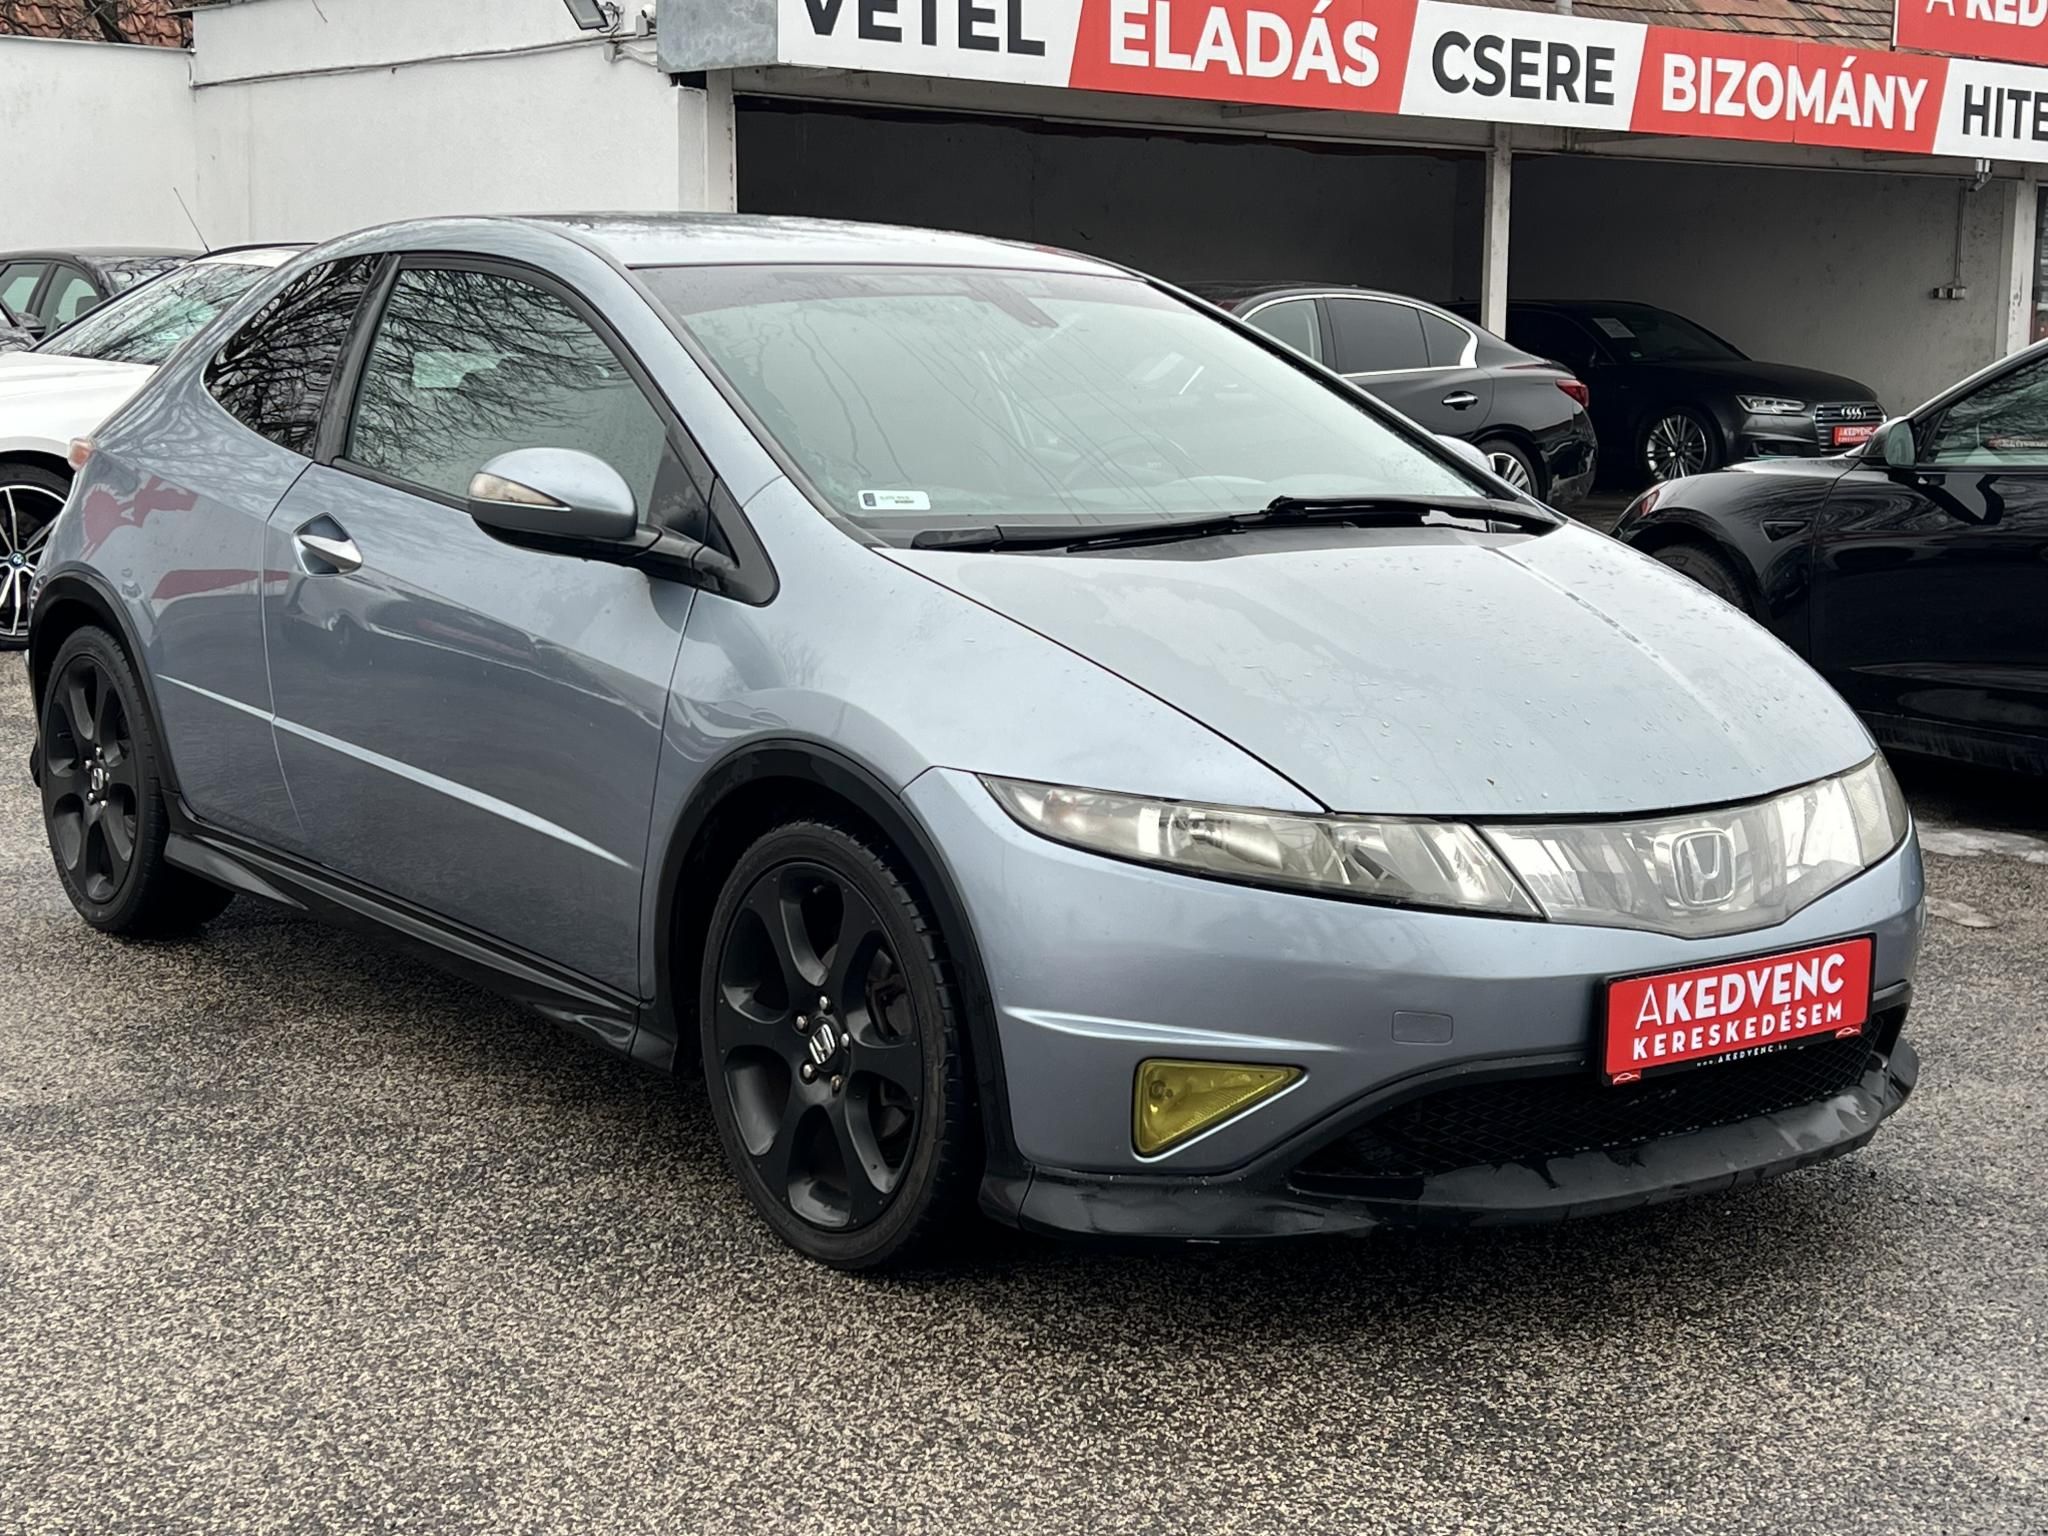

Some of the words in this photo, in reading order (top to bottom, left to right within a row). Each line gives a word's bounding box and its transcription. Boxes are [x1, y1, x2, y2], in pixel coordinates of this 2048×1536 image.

[1109, 0, 1380, 88] ELADÁS
[1432, 30, 1616, 106] CSERE
[1661, 53, 1929, 132] BIZOMÁNY
[1632, 1000, 1843, 1061] KERESKEDÉSEM
